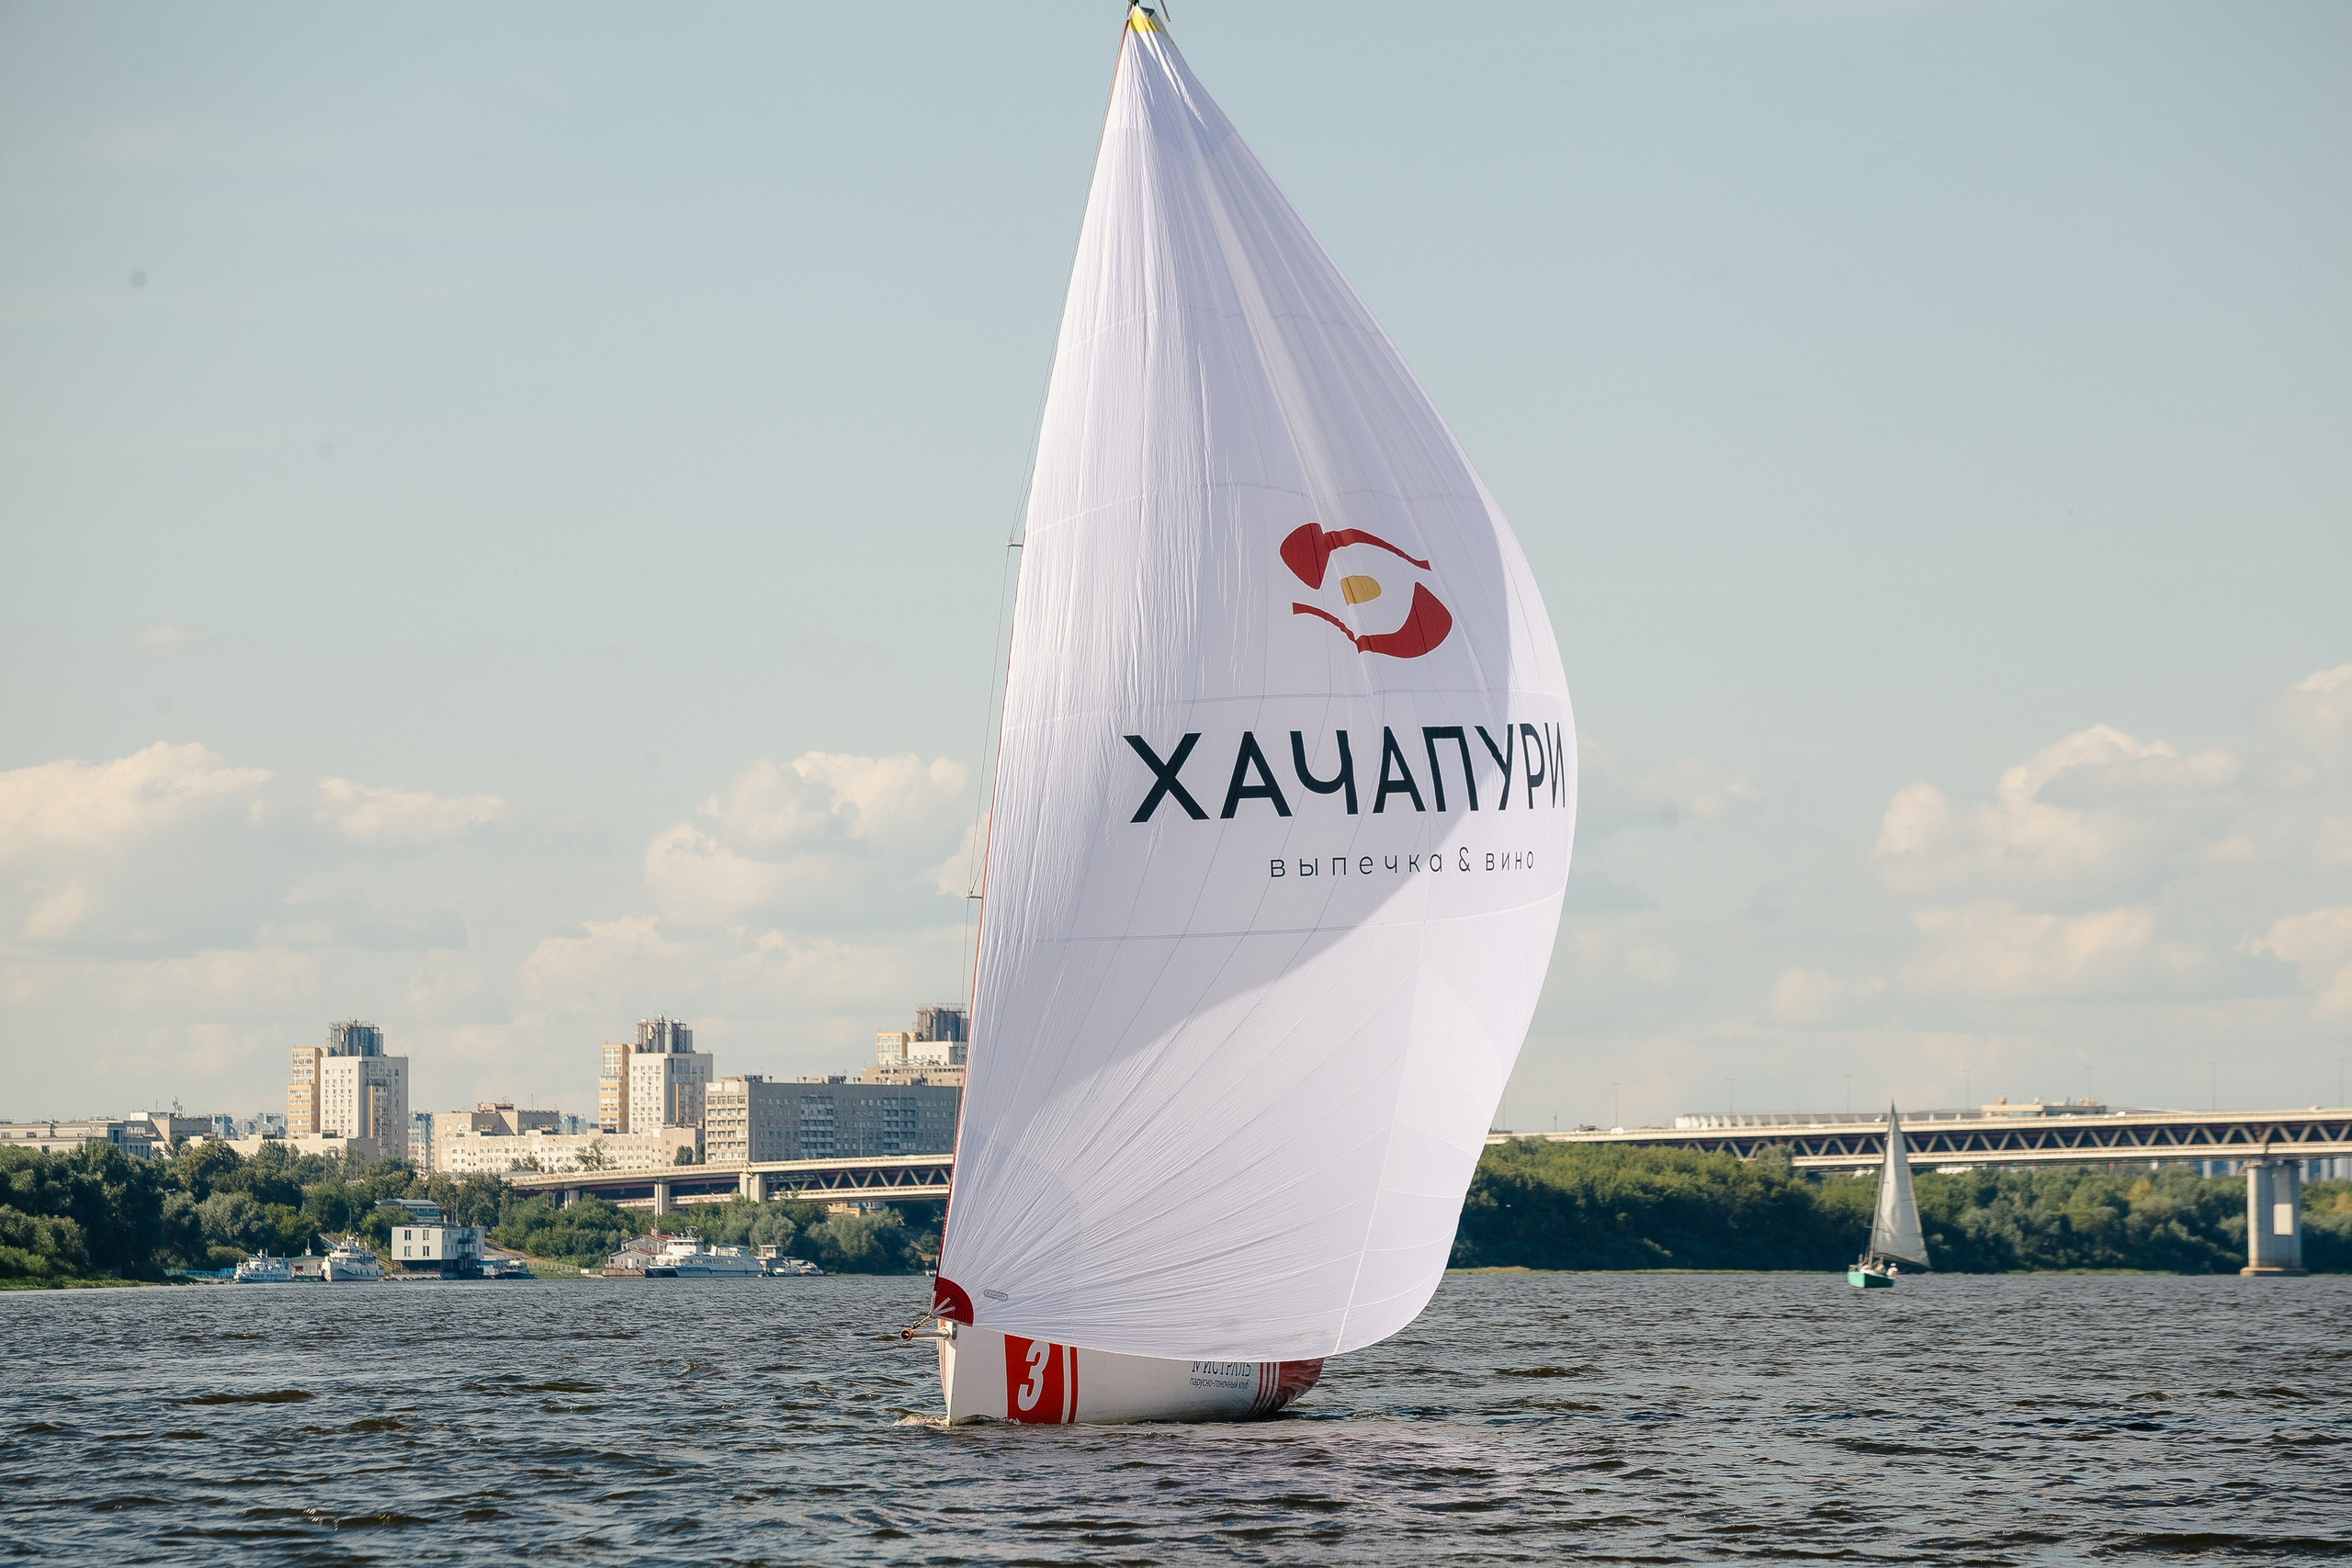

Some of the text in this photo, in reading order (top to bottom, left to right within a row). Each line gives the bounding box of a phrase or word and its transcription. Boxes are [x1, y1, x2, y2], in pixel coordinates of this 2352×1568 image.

[1122, 722, 1566, 823] ХАЧАПУРИ
[1270, 846, 1535, 878] выпечка & вино
[1017, 1340, 1050, 1411] 3
